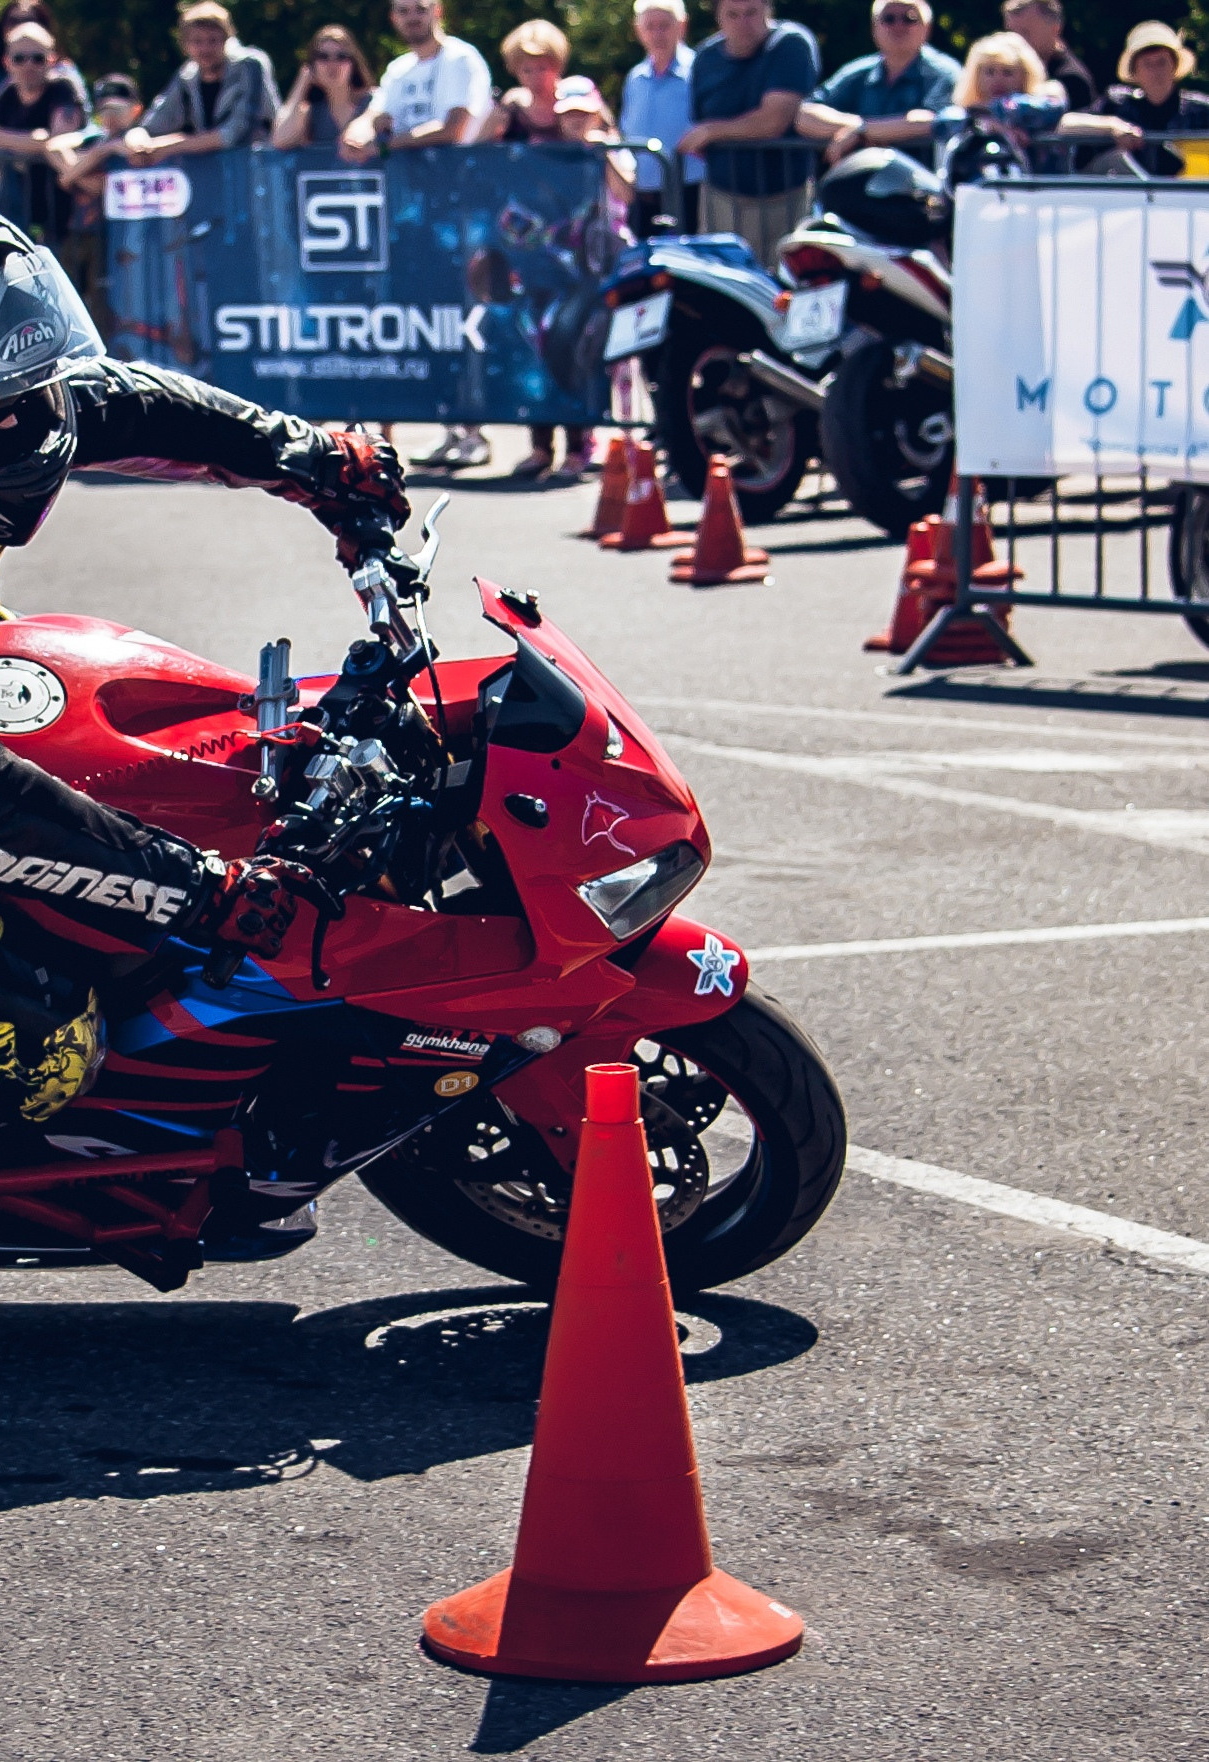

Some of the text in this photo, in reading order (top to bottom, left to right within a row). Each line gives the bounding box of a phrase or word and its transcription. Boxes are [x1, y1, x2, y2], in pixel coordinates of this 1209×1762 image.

[303, 192, 384, 251] ST
[2, 322, 55, 360] Airoh
[215, 303, 488, 353] STILTRONIK
[1016, 375, 1209, 419] MOT
[402, 1032, 491, 1054] gymkhana
[440, 1075, 473, 1092] D1
